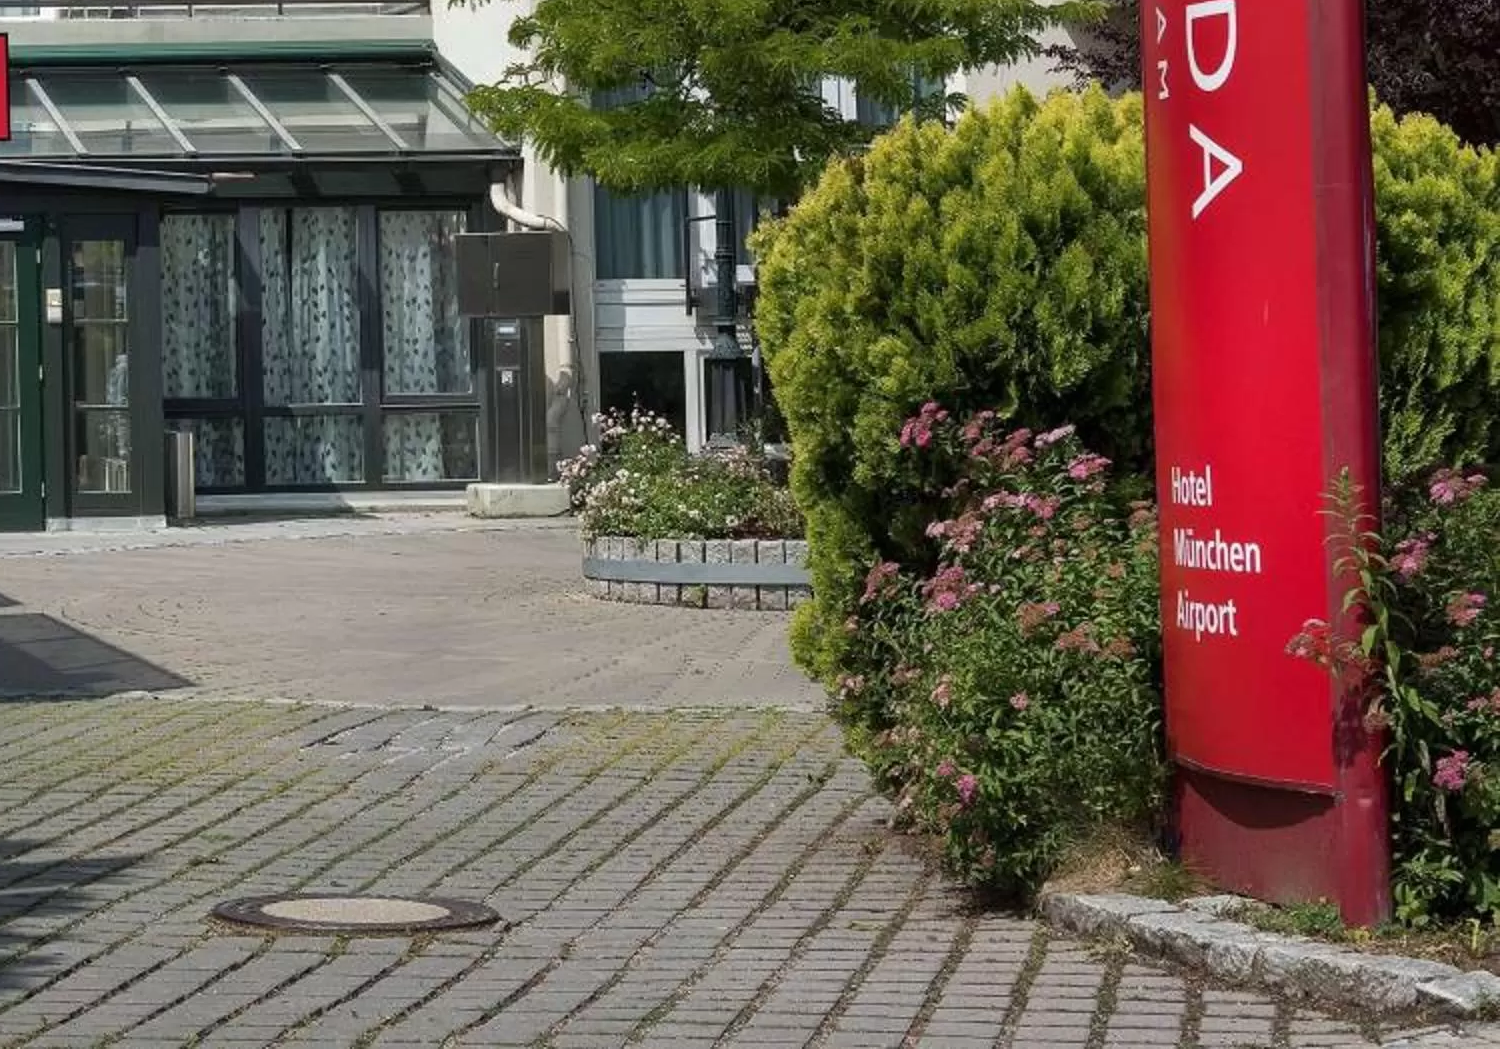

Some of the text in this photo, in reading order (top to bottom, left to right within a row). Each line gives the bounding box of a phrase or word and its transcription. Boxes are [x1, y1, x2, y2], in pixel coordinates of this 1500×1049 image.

[1171, 465, 1213, 507] Hotel
[1173, 528, 1262, 573] München
[1176, 590, 1238, 642] Airport
